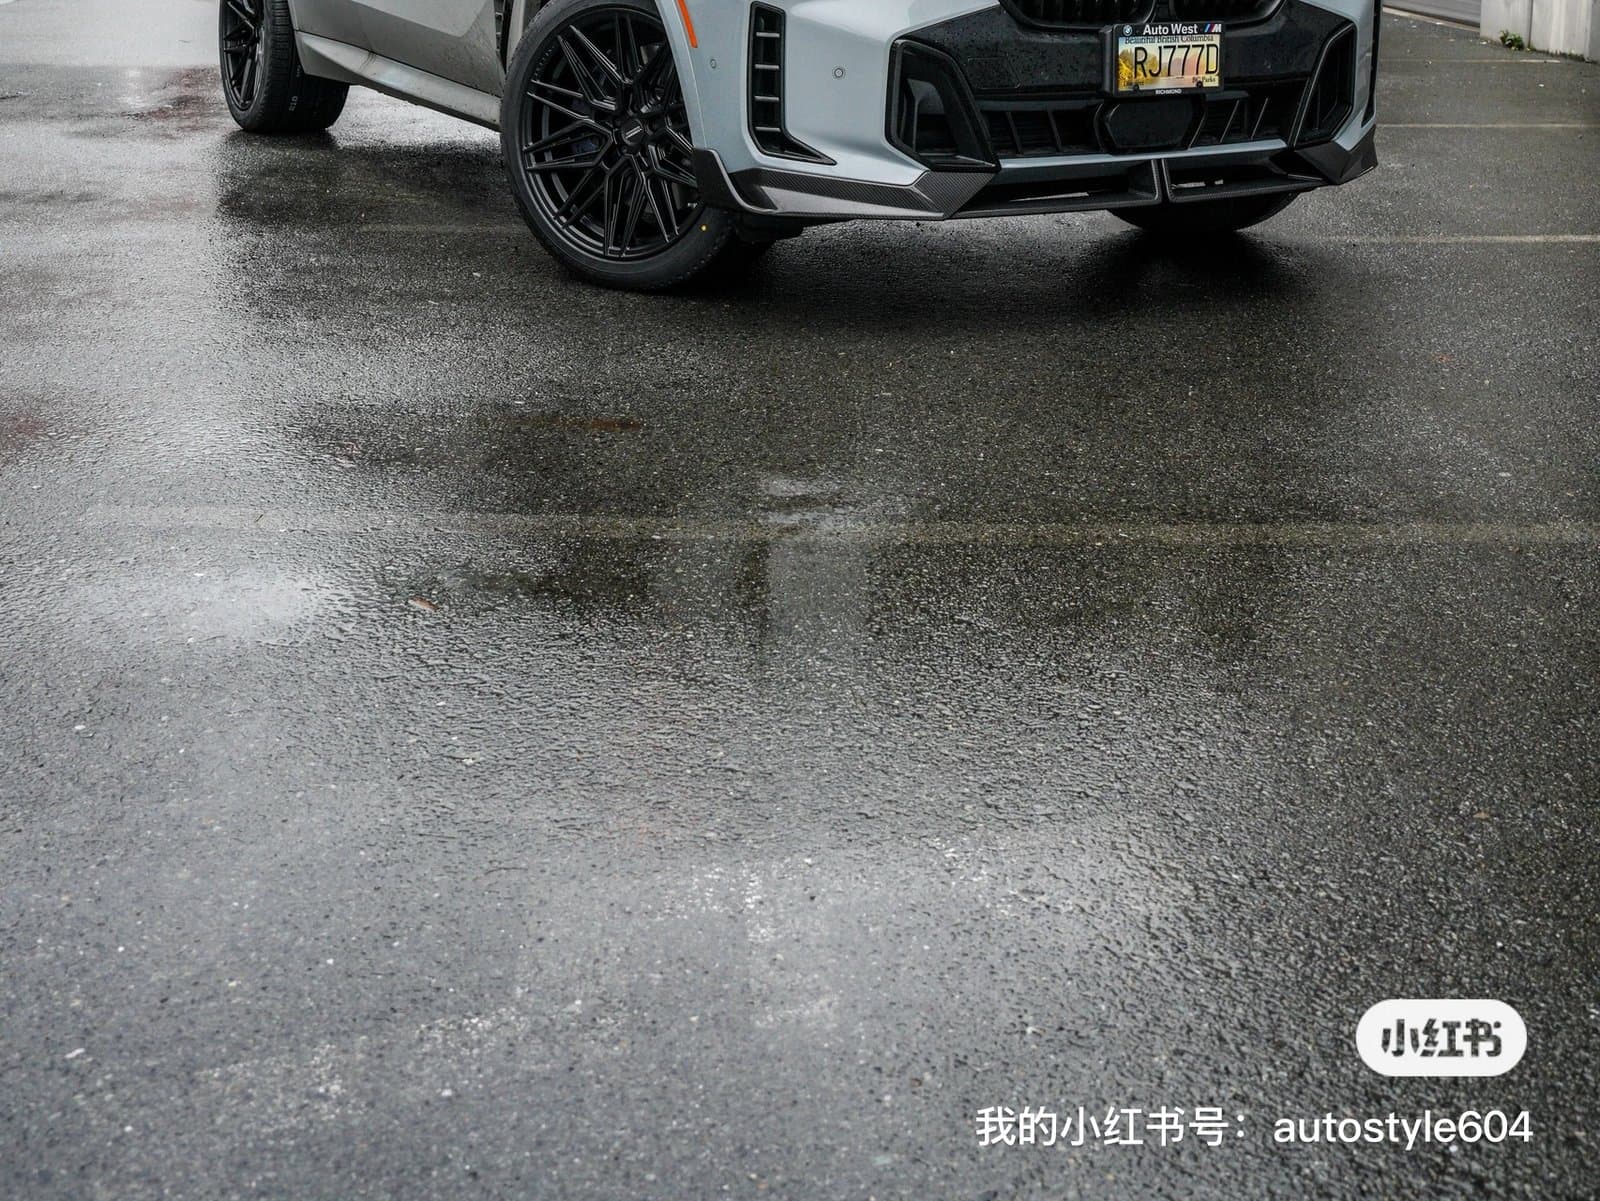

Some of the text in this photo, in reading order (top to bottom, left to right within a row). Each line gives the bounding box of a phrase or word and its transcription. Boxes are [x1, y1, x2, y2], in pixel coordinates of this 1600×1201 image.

[1143, 24, 1169, 35] Auto
[1171, 23, 1198, 34] West
[1134, 44, 1219, 78] RJ777D
